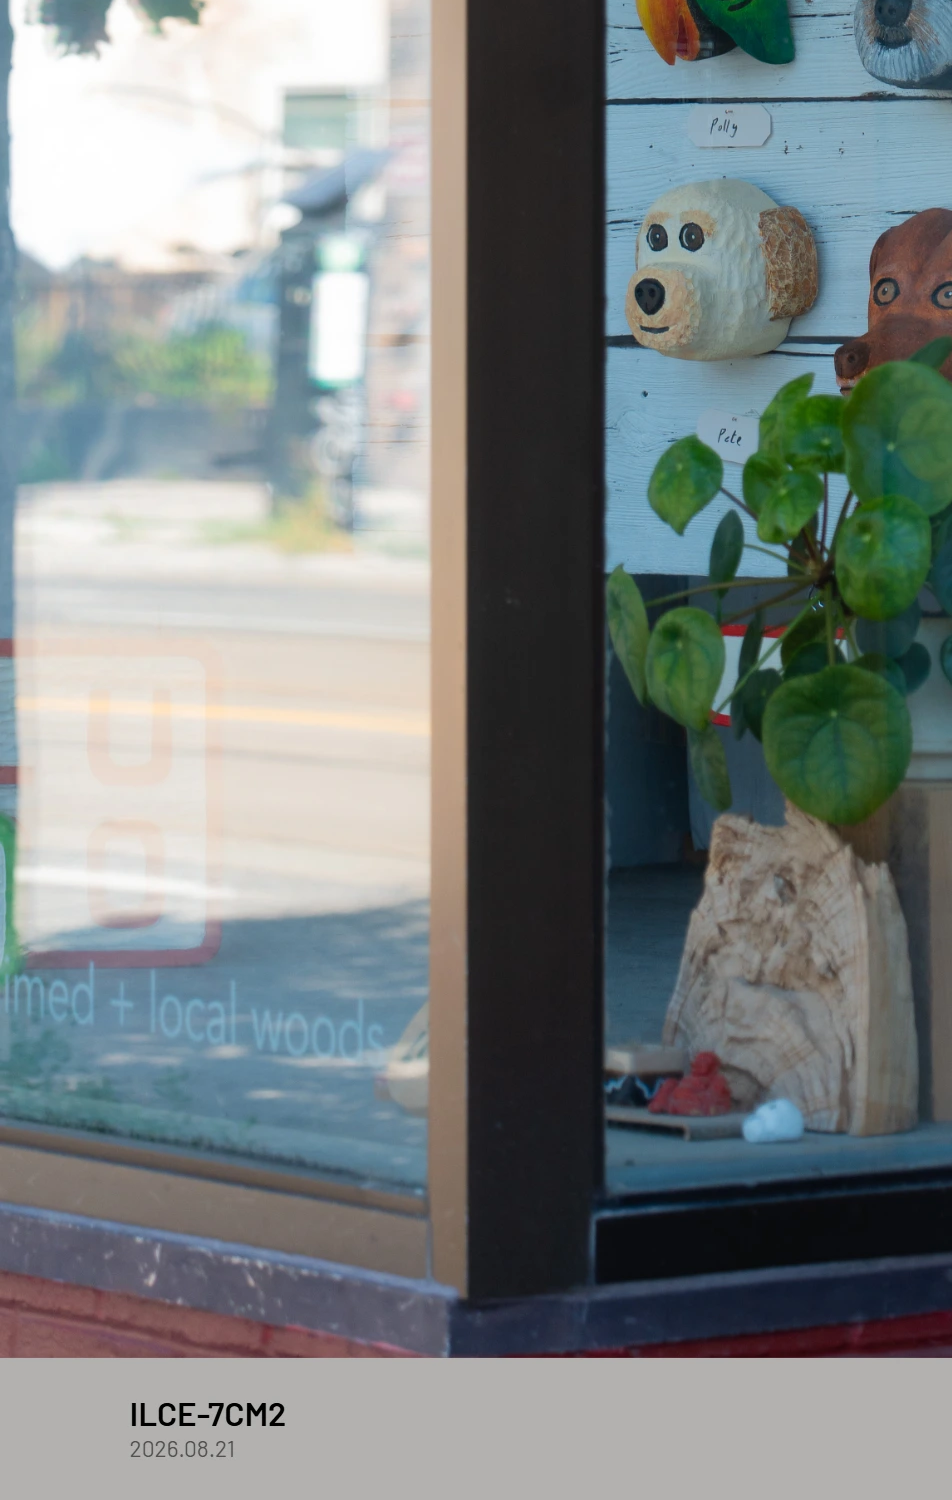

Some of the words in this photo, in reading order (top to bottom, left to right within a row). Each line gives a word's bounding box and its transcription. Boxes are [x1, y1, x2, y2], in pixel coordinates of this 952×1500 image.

[710, 117, 738, 138] Polly
[717, 428, 742, 446] Pete
[149, 969, 237, 1045] local
[251, 999, 385, 1068] woods
